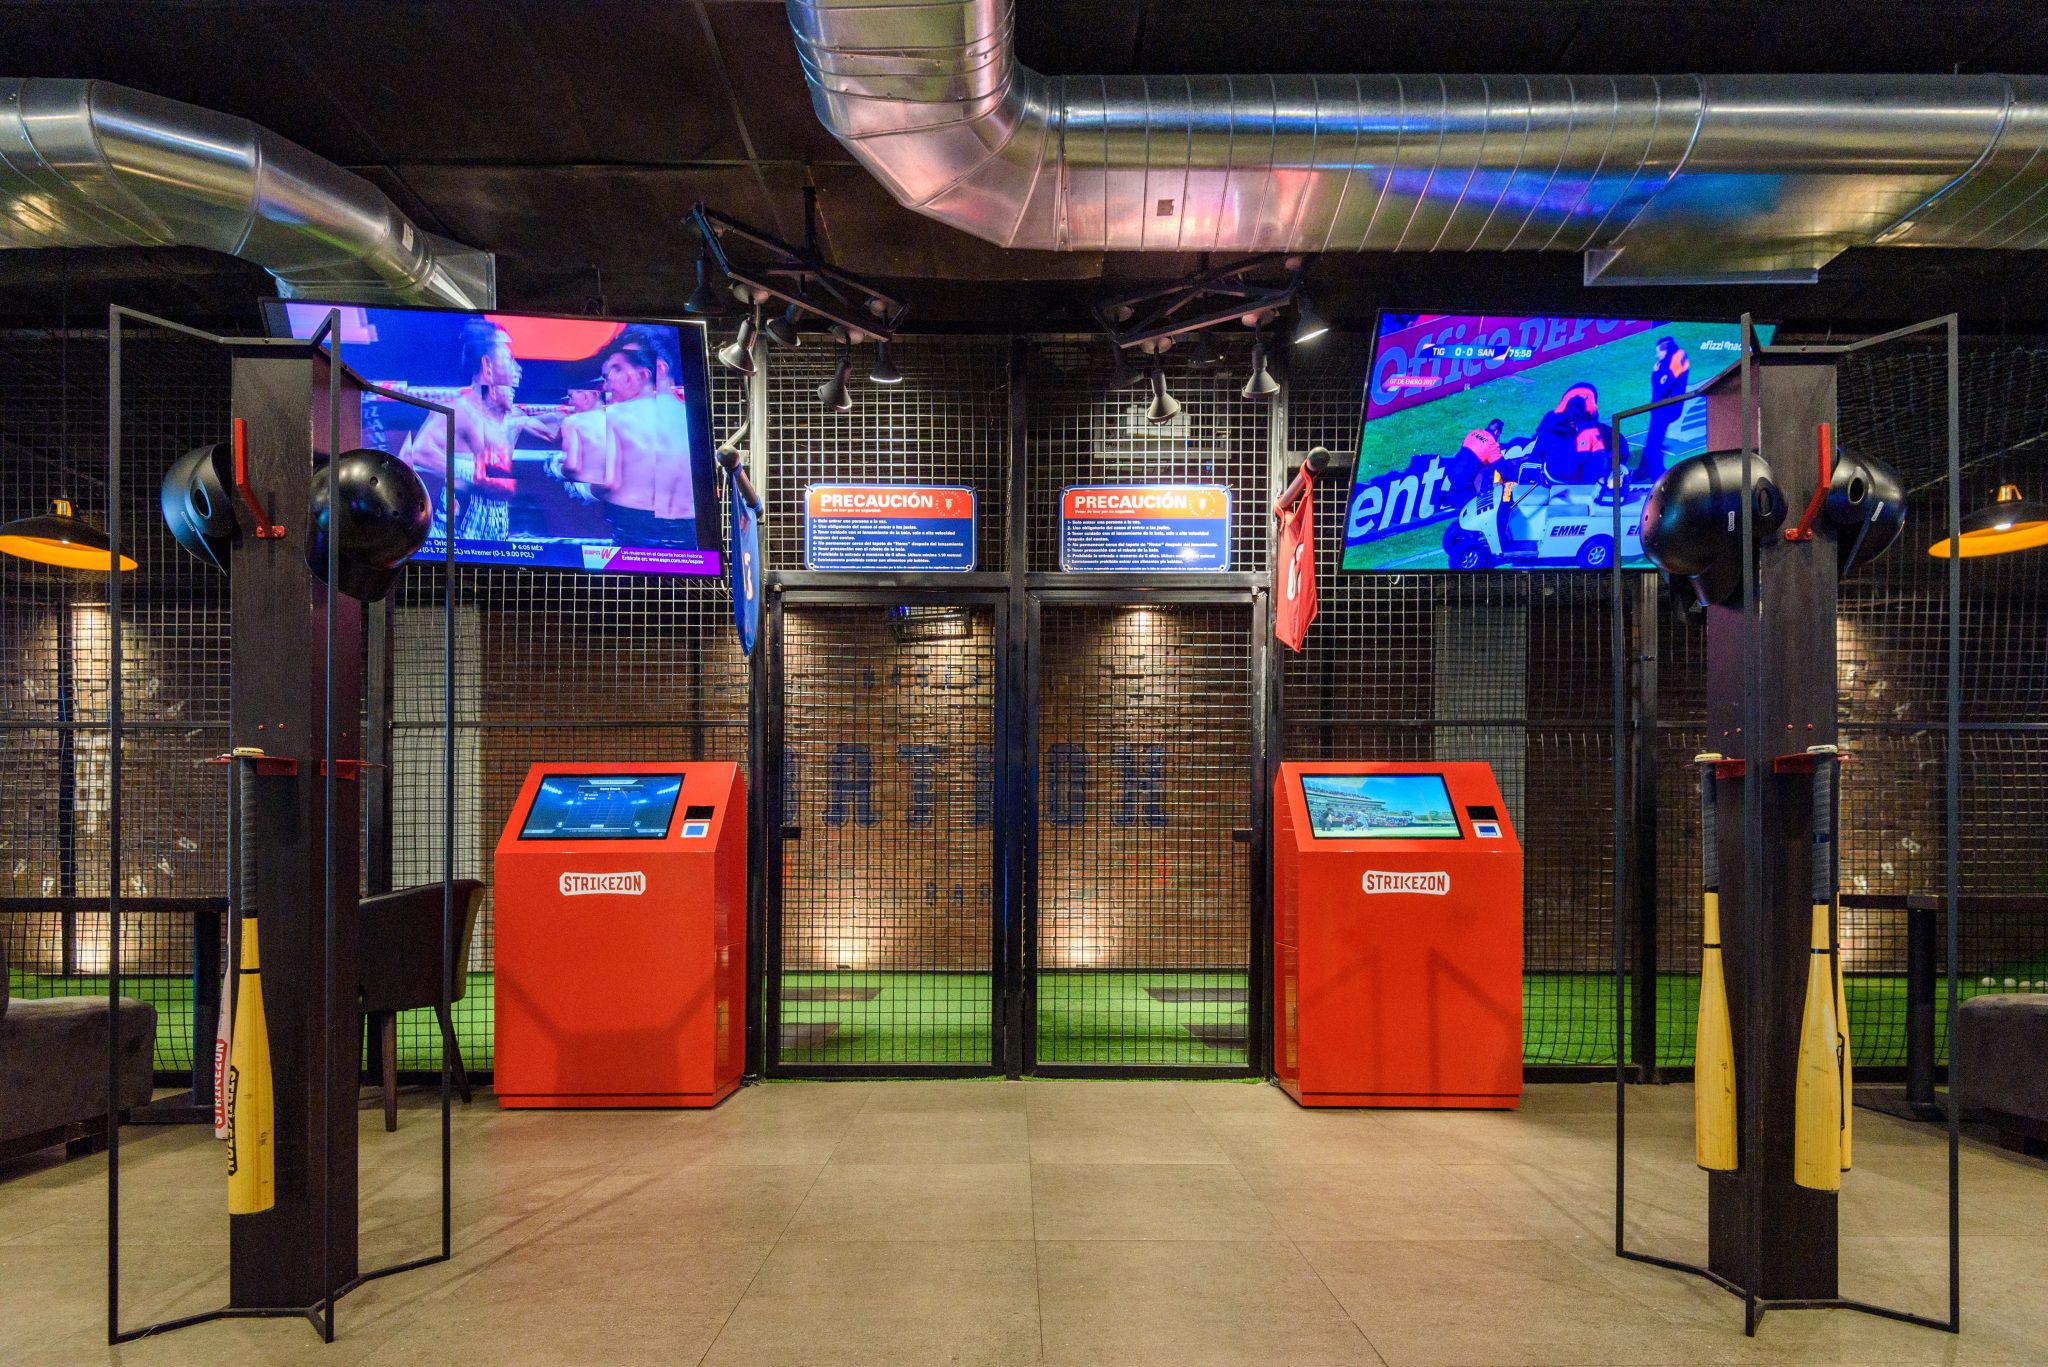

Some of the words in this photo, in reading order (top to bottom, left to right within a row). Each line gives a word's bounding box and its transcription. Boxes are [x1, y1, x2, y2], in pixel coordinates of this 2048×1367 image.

[1432, 347, 1446, 356] TIG
[1477, 349, 1495, 357] SAN
[1509, 349, 1532, 358] 75:58
[1370, 322, 1511, 405] Office
[820, 492, 933, 508] PRECAUCIÓN
[1075, 493, 1187, 509] PRECAUCIÓN
[1550, 525, 1588, 537] EMME
[564, 875, 641, 892] STRIKEZON
[1367, 874, 1444, 892] STRIKEZON
